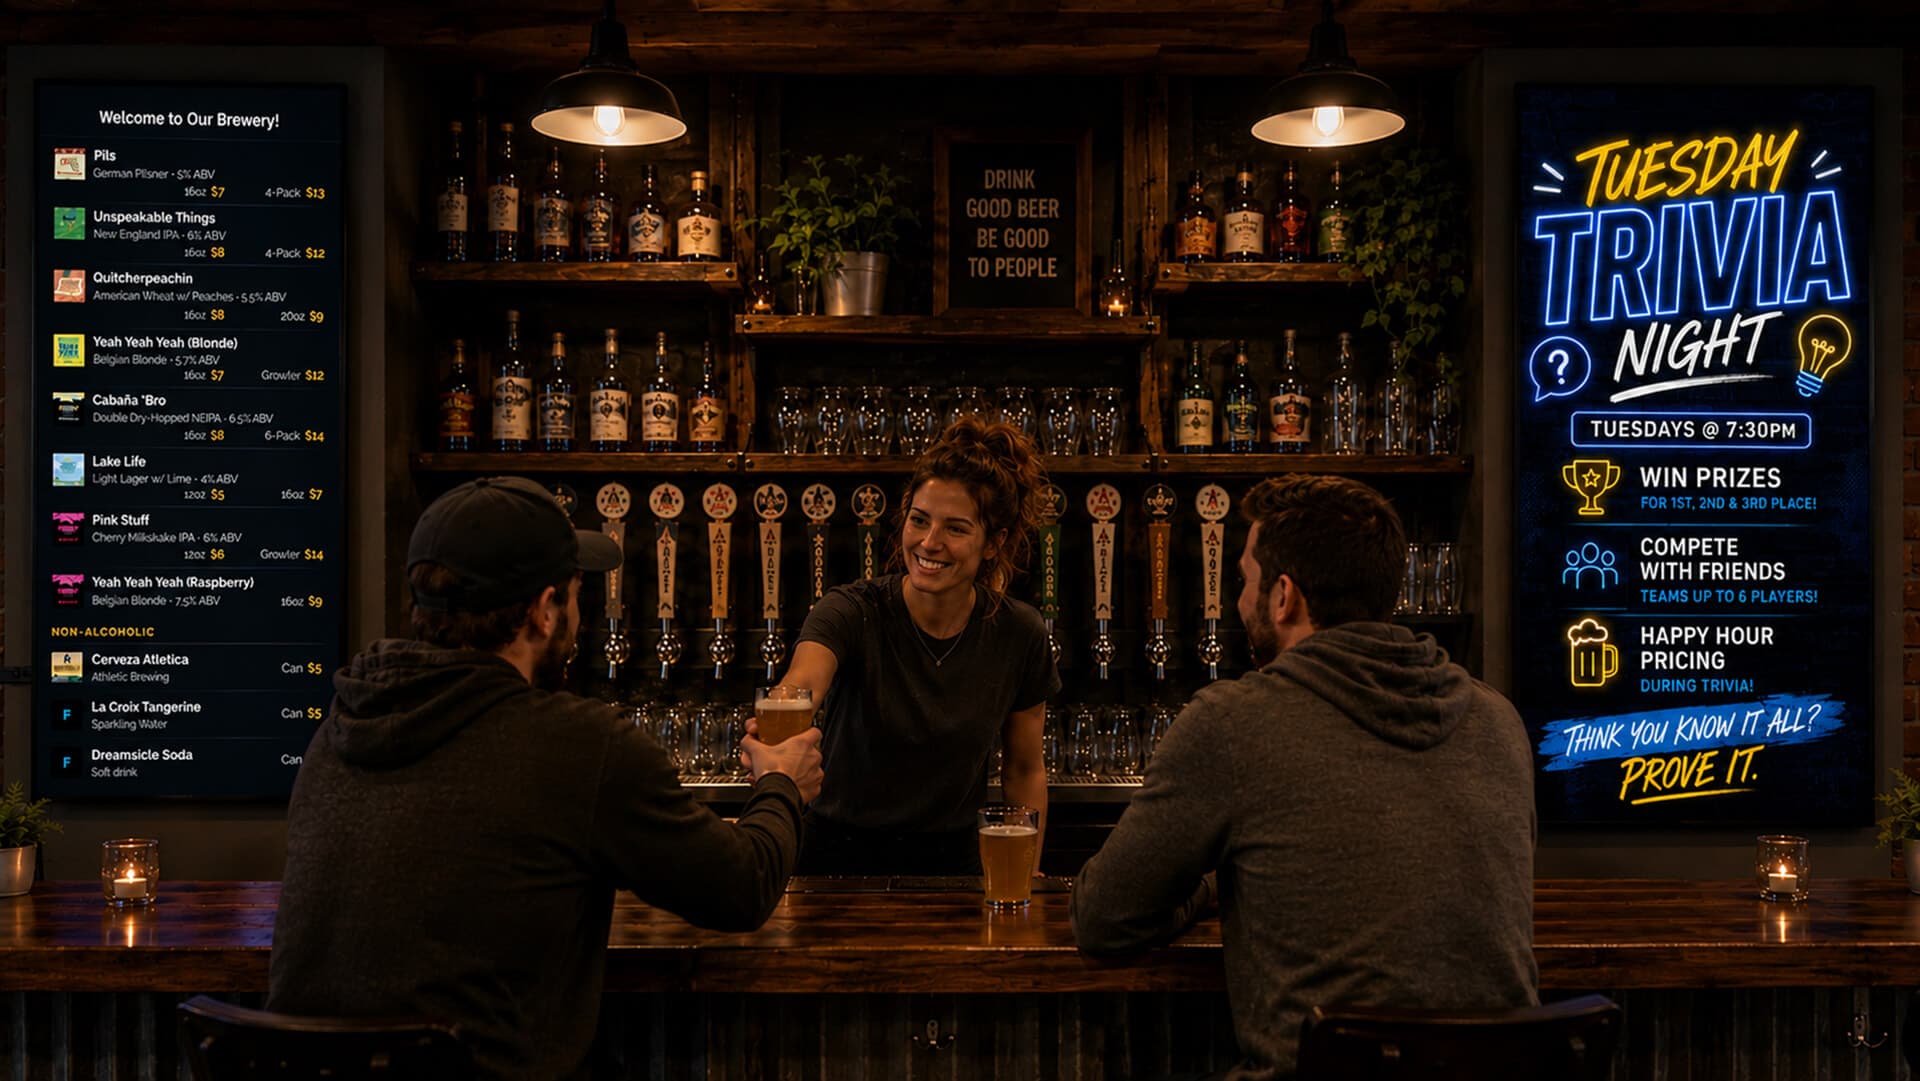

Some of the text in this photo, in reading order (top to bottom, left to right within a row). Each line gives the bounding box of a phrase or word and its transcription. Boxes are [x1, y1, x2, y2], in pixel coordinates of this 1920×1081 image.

[99, 111, 279, 131] Welcome to Our Brewery!
[94, 149, 116, 161] Pils
[93, 168, 215, 180] German Pilsner 5% ABV
[1576, 129, 1799, 207] TUESDAY
[985, 170, 1035, 189] DRINK
[185, 186, 224, 198] 16oz $7
[265, 187, 325, 199] 4-Pack $13
[967, 198, 1059, 218] GOOD BEER
[94, 211, 215, 226] Unspeakable Things
[94, 229, 226, 241] New England IPA 6% ABV
[977, 228, 1049, 248] BE GOOD
[185, 247, 224, 258] 16oz $8
[265, 247, 325, 258] 4-Pack $12
[1535, 190, 1850, 325] TRIVIA
[968, 257, 1057, 277] TO PEOPLE
[93, 272, 193, 286] Quitcherpeachin
[93, 290, 287, 303] American Wheat w/ Peaches 55% ABV
[185, 309, 224, 320] 16oz $8
[281, 310, 324, 323] 20oz $9
[93, 336, 237, 350] Yeah Yeah Yeah (Blonde)
[1614, 311, 1784, 383] NIGHT
[93, 354, 220, 366] Belgian Blonde 57% ABV
[185, 369, 224, 381] 16oz $7
[261, 370, 324, 380] Growler $12
[93, 394, 138, 405] Cabaña
[93, 412, 128, 422] Double
[130, 412, 189, 424] Dry-Hopped
[192, 413, 222, 423] NEIPA
[252, 413, 274, 423] ABV
[185, 430, 224, 440] 16oz $8
[1591, 420, 1795, 439] TUESDAYS @ 7:30PM
[265, 430, 324, 442] 6-Pack $14
[93, 455, 146, 467] Lake Life
[93, 474, 238, 486] Light Lager w/ Lime 4% ABV
[1640, 467, 1781, 488] WIN PRIZES
[185, 489, 224, 500] 12oz $5
[282, 488, 322, 500] 16oz $7
[1641, 496, 1816, 510] FOR 1ST, 2ND & 3RD PLACE!
[93, 514, 149, 525] Pink Stuff
[92, 532, 242, 544] Cherry Milkshake IPA 6% ABV
[1641, 537, 1738, 556] COMPETE
[185, 549, 224, 560] 12oz $6
[261, 549, 323, 560] Growler $14
[1640, 562, 1785, 580] WITH FRIENDS
[92, 577, 254, 590] Yeah Yeah Yeah (Raspberry)
[92, 595, 129, 608] Belgian
[131, 595, 166, 605] Blonde
[199, 595, 221, 605] ABV
[282, 595, 322, 608] 16oz $9
[1640, 589, 1817, 603] TEAMS UP TO 6 PLAYERS!
[52, 627, 154, 636] NON-ALCOHOLIC
[1641, 627, 1773, 644] HAPPY HOUR
[92, 653, 140, 665] Cerveza
[143, 654, 189, 665] Atletica
[1642, 651, 1724, 669] PRICING
[282, 662, 322, 674] Can $5
[92, 672, 169, 684] Athletic Brewing
[1641, 679, 1753, 692] DURING TRIVIA!
[92, 701, 201, 715] La Croix Tangerine
[281, 707, 321, 719] Can $5
[92, 719, 167, 731] Sparkling Water
[1563, 703, 1823, 757] THINK YOU KNOW IT ALL?
[92, 749, 193, 760] Dreamsicle Soda
[281, 754, 302, 765] Can
[91, 767, 137, 777] Soft drink
[1619, 744, 1766, 801] PROVE IT.
